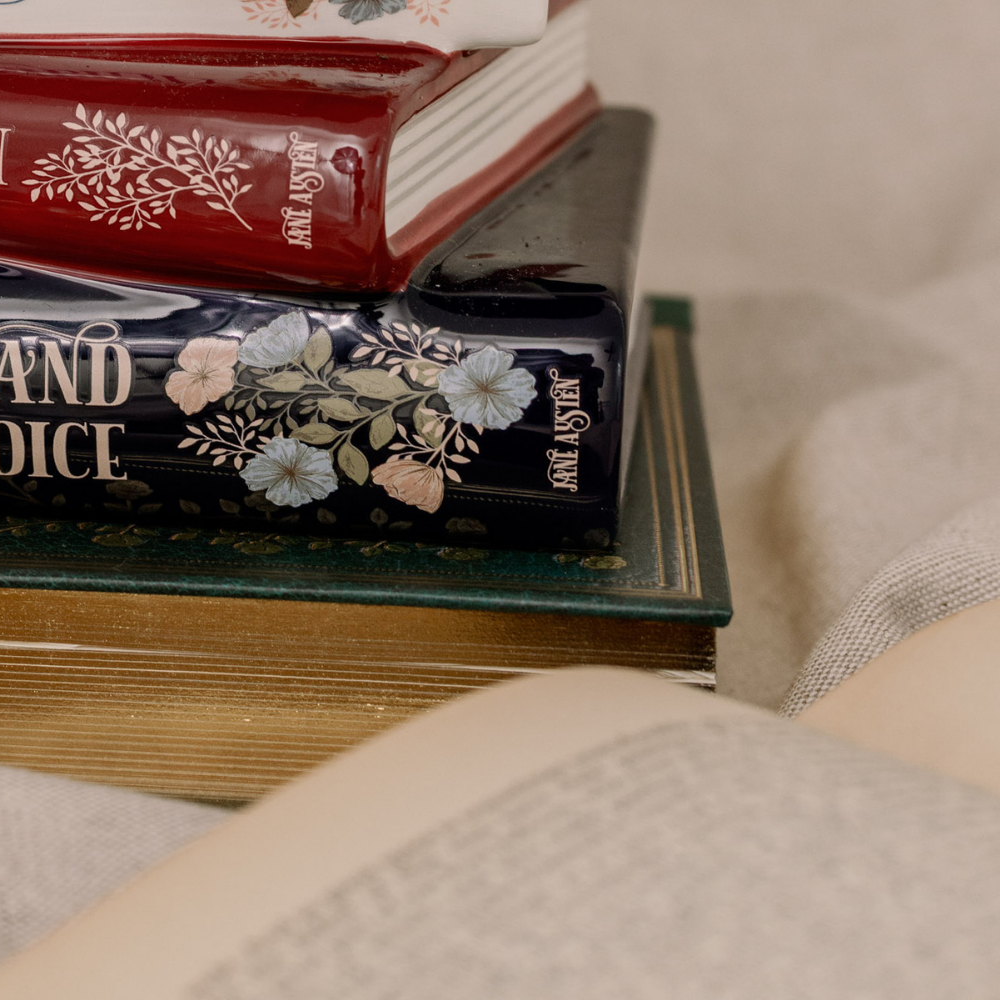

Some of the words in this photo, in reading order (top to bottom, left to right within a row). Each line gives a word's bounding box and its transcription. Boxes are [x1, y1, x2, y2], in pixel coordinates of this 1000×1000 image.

[288, 131, 324, 206] AUSTEN
[281, 206, 313, 250] JANE
[549, 368, 591, 446] AUSTEN
[546, 449, 578, 492] JANE
